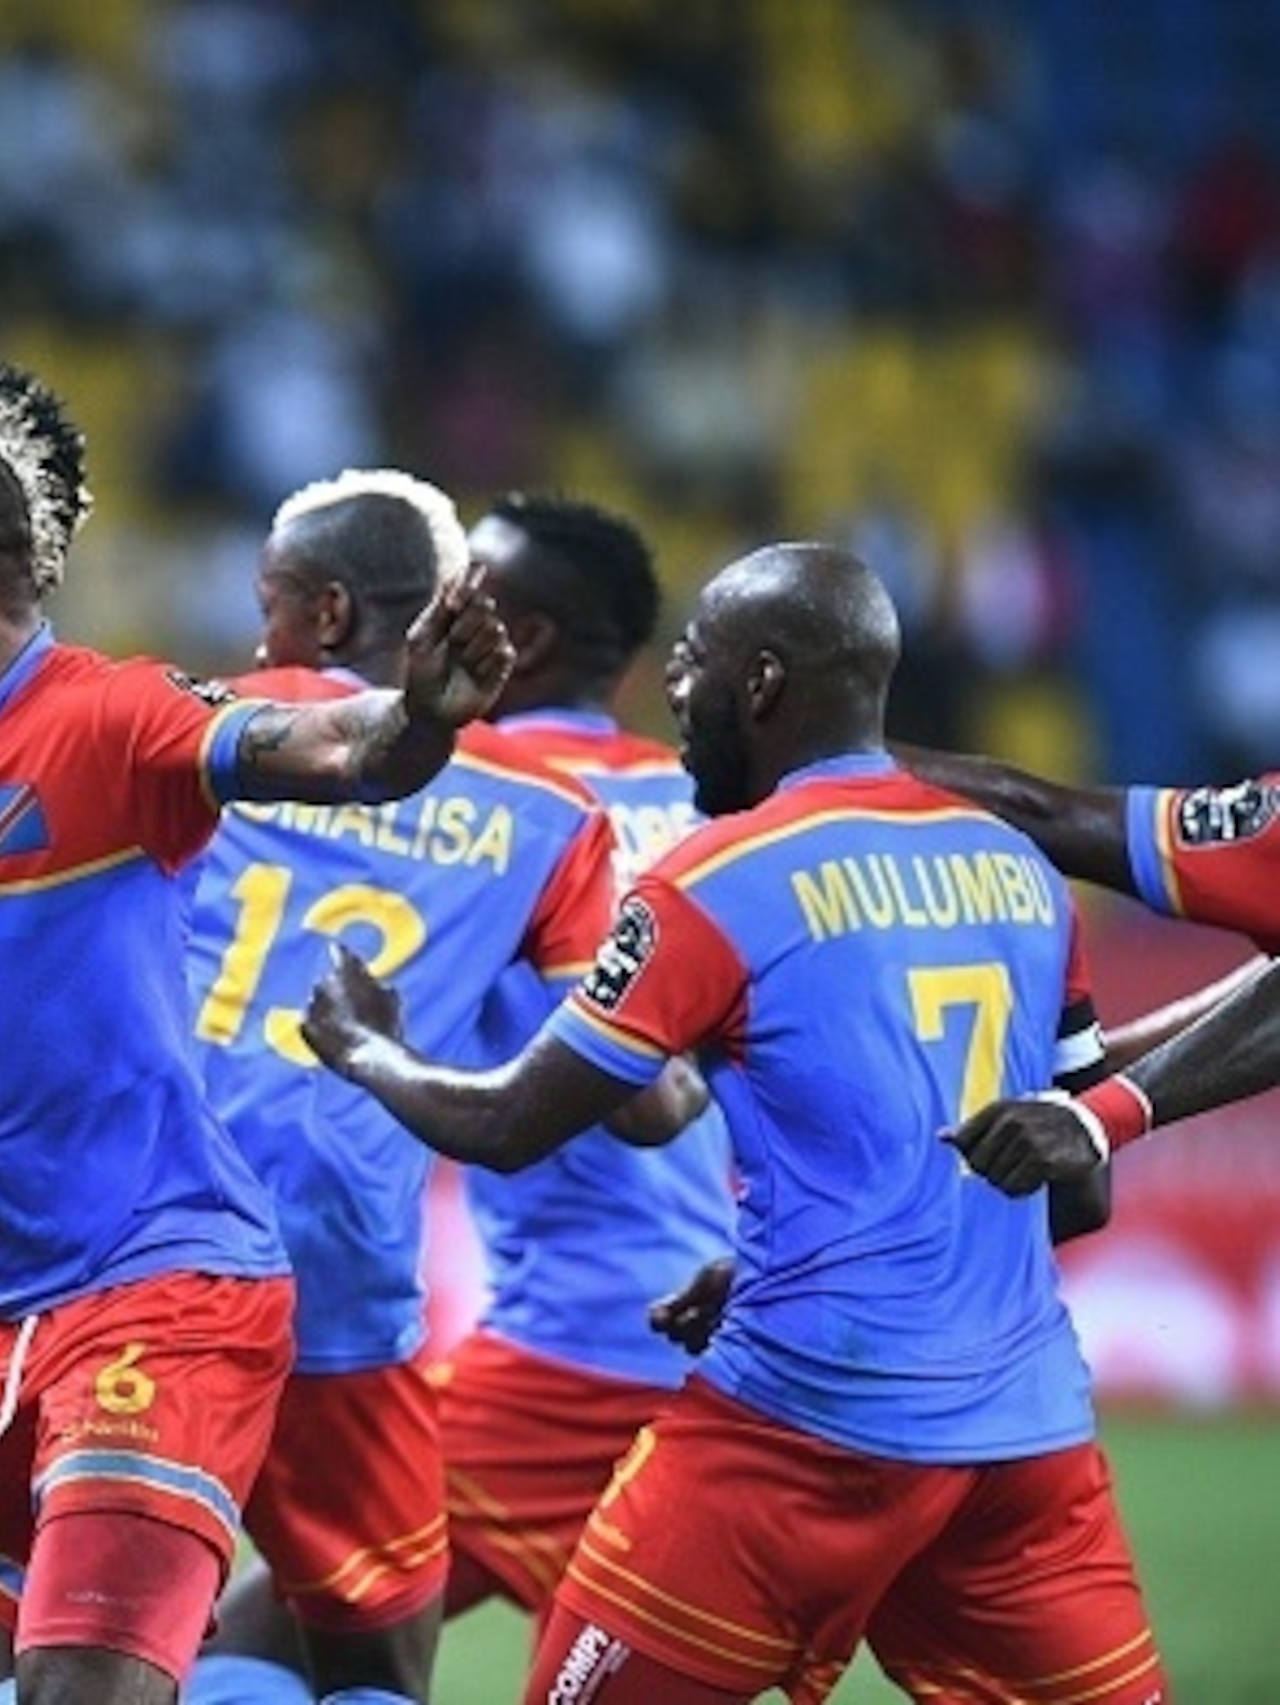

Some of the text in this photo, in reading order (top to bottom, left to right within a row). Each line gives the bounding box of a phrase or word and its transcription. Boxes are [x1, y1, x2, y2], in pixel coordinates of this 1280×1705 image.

[220, 796, 513, 876] MALISA
[790, 850, 1056, 943] MULUMBU
[907, 963, 1015, 1176] 7
[94, 1342, 157, 1416] 6
